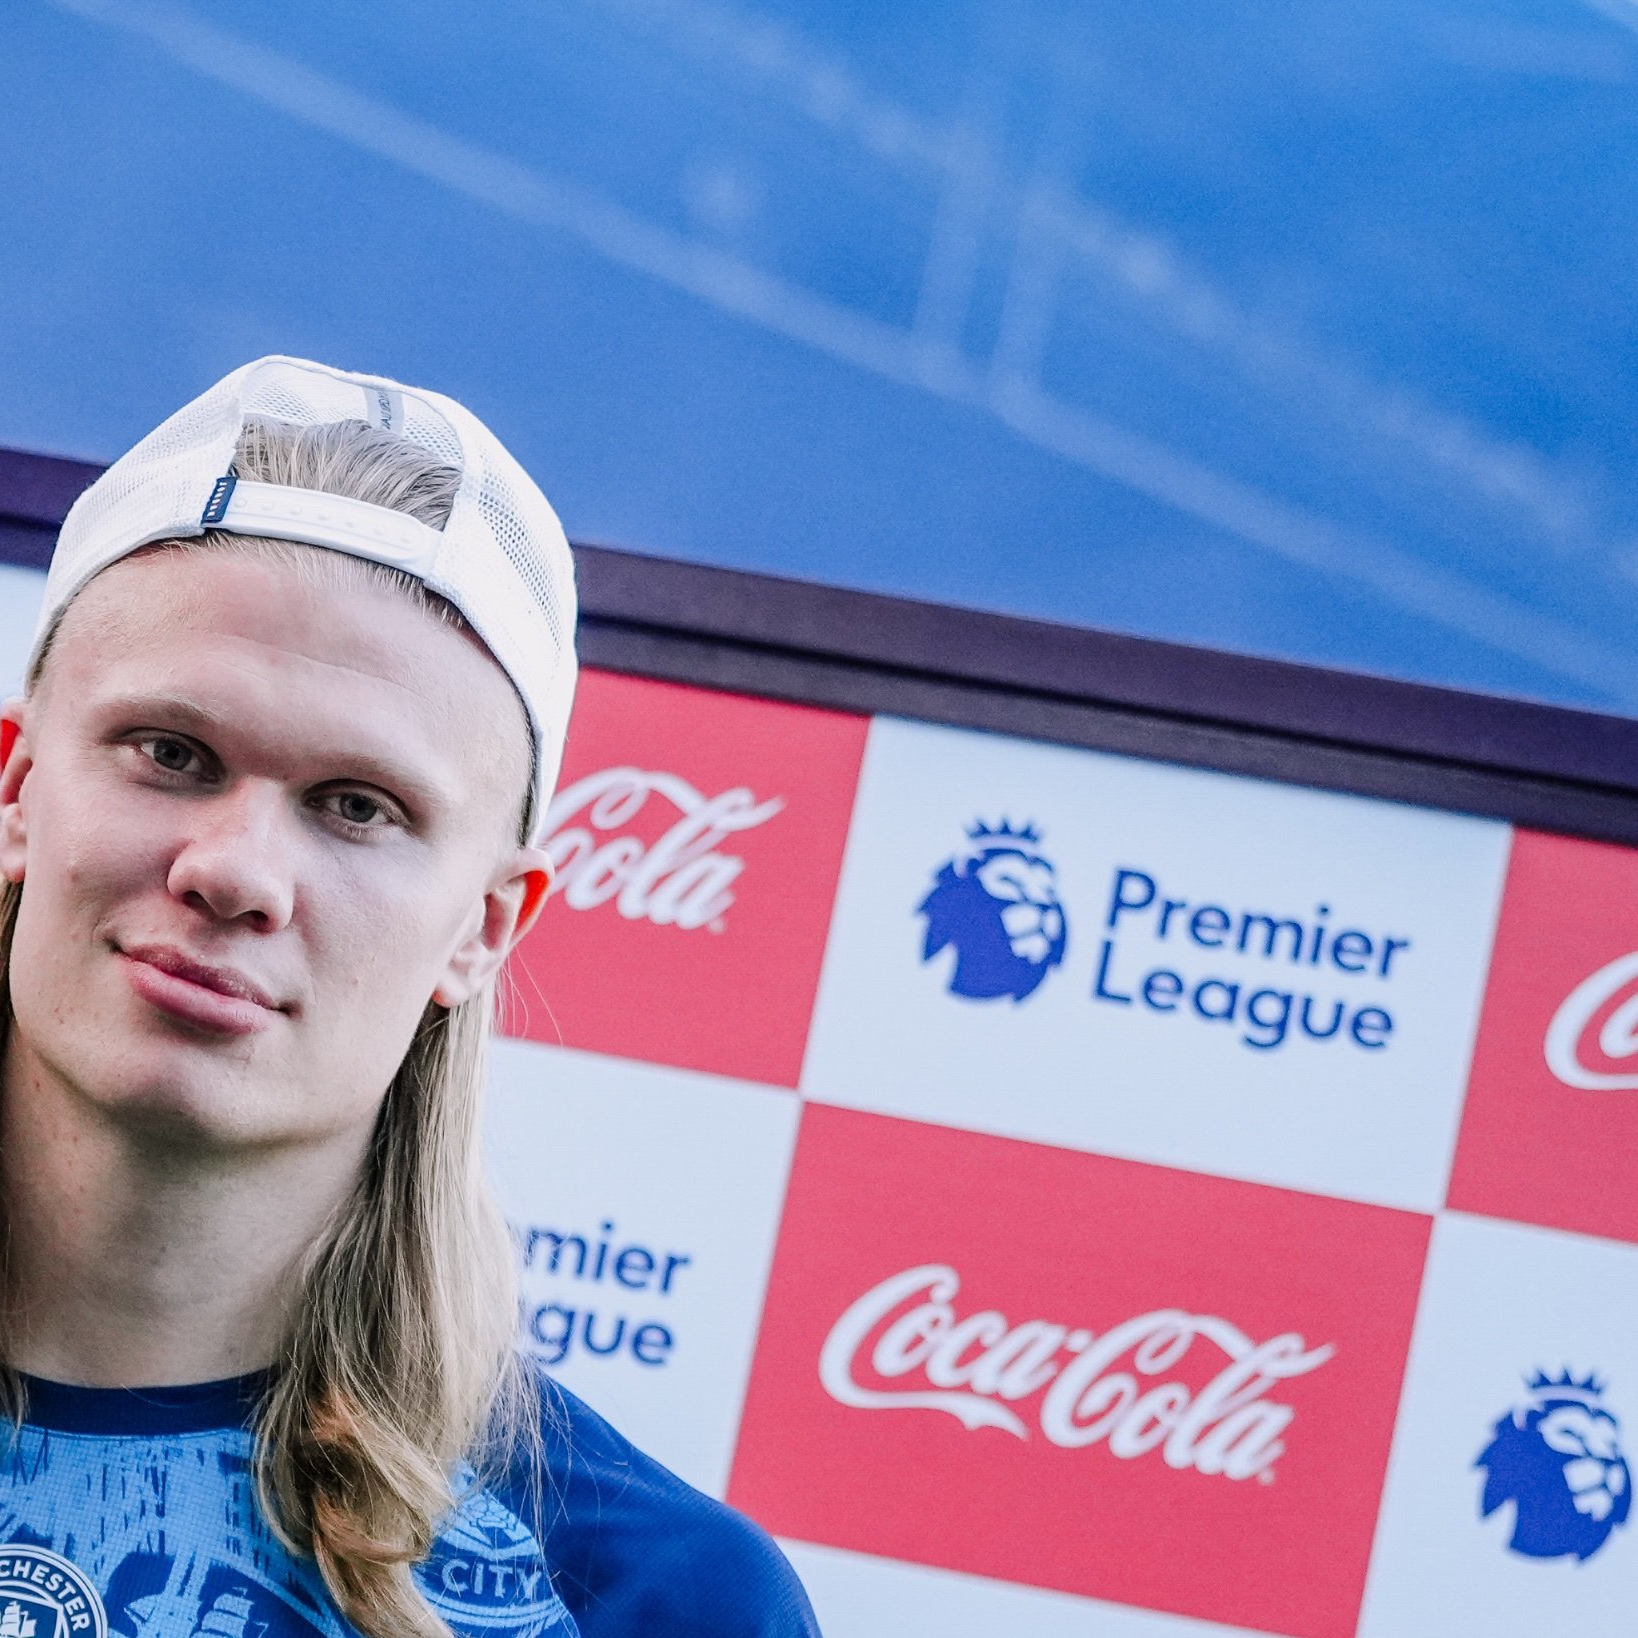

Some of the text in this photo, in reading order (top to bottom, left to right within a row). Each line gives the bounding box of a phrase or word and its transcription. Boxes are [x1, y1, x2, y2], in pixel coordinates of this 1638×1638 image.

[1106, 869, 1409, 977] Premier
[1094, 939, 1394, 1050] League
[523, 1219, 691, 1294] mier
[531, 1303, 675, 1366] gue
[820, 1265, 1332, 1482] Coca-Cola
[441, 1558, 543, 1600] CITY
